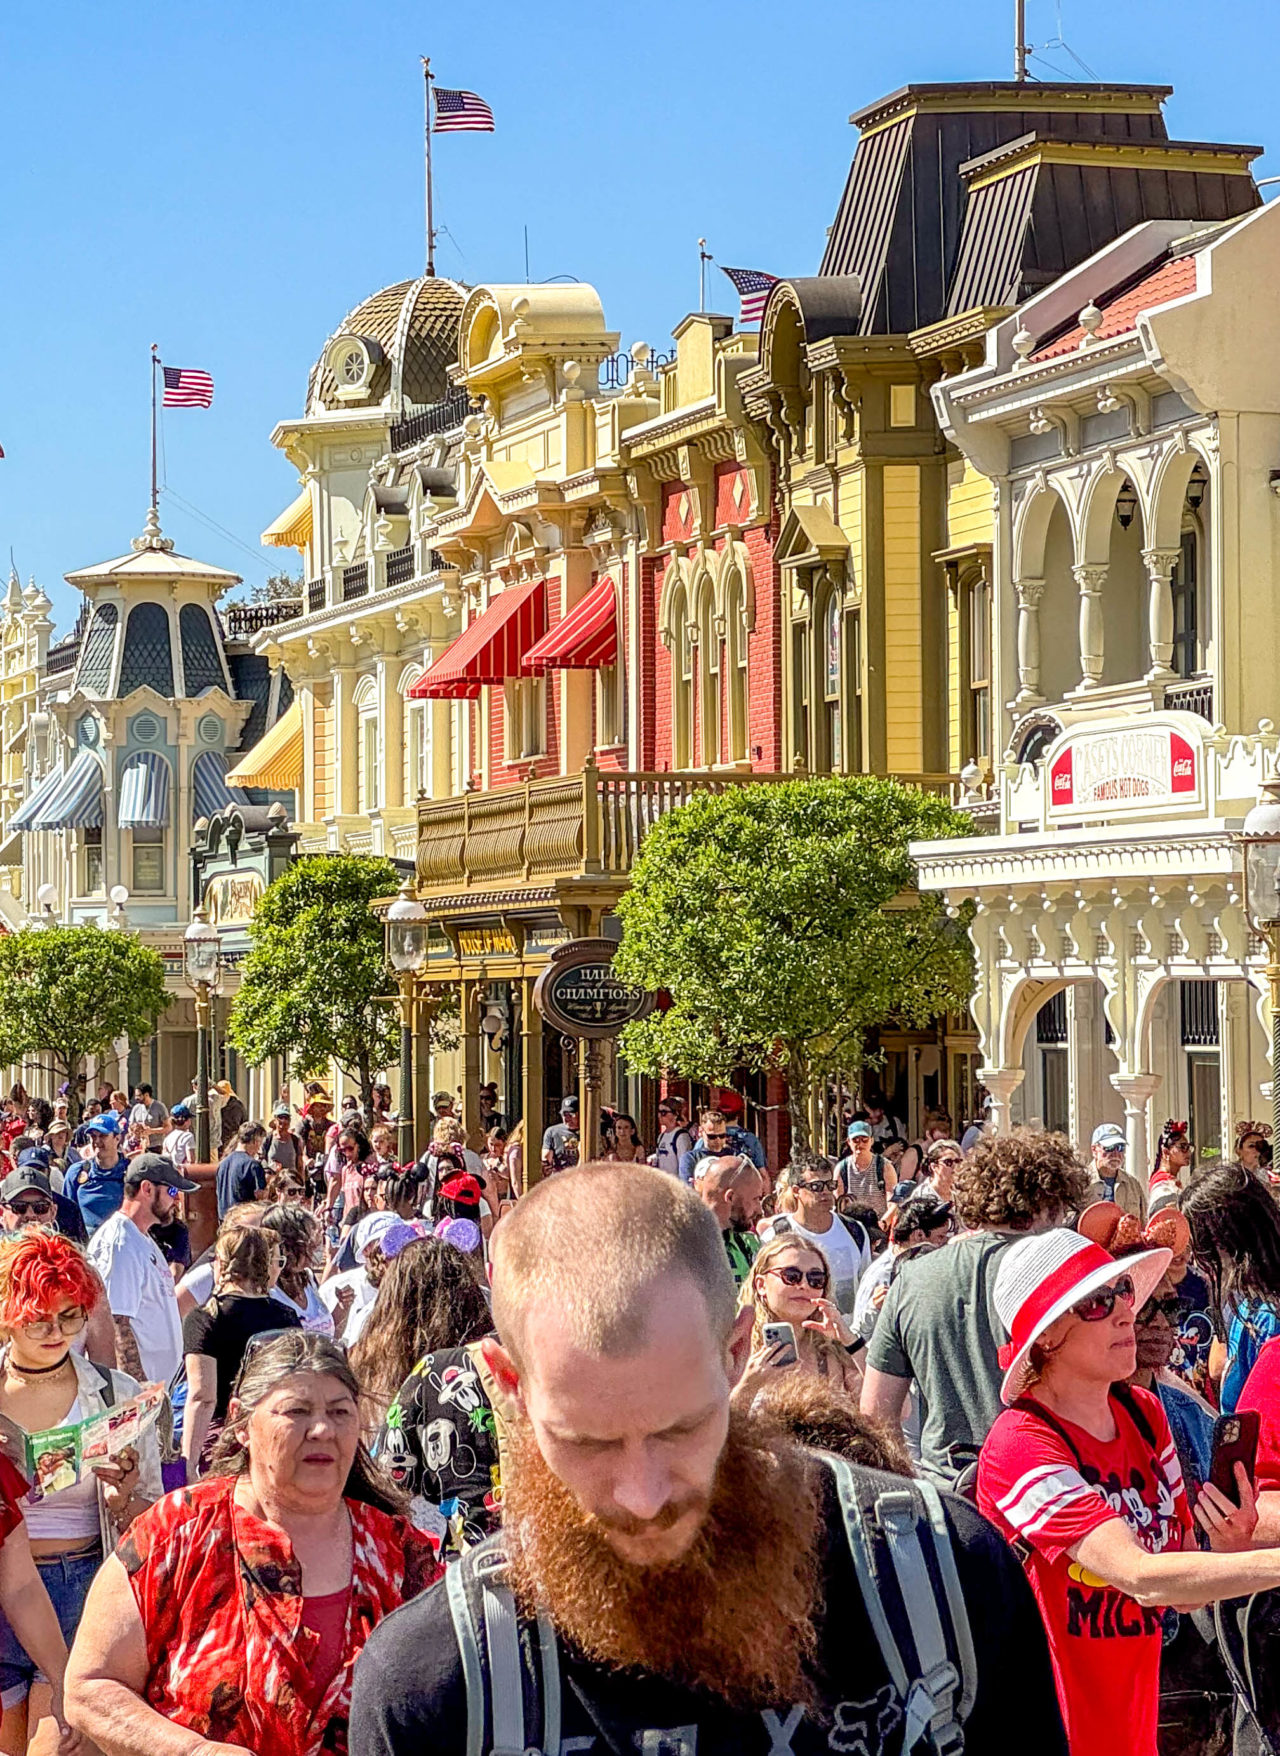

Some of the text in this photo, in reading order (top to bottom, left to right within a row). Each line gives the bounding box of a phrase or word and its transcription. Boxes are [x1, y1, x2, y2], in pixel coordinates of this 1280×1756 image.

[1093, 777, 1150, 802] FAMOUS HOT DOGS
[580, 969, 617, 980] HALL
[556, 988, 640, 1000] CHAMPIONS
